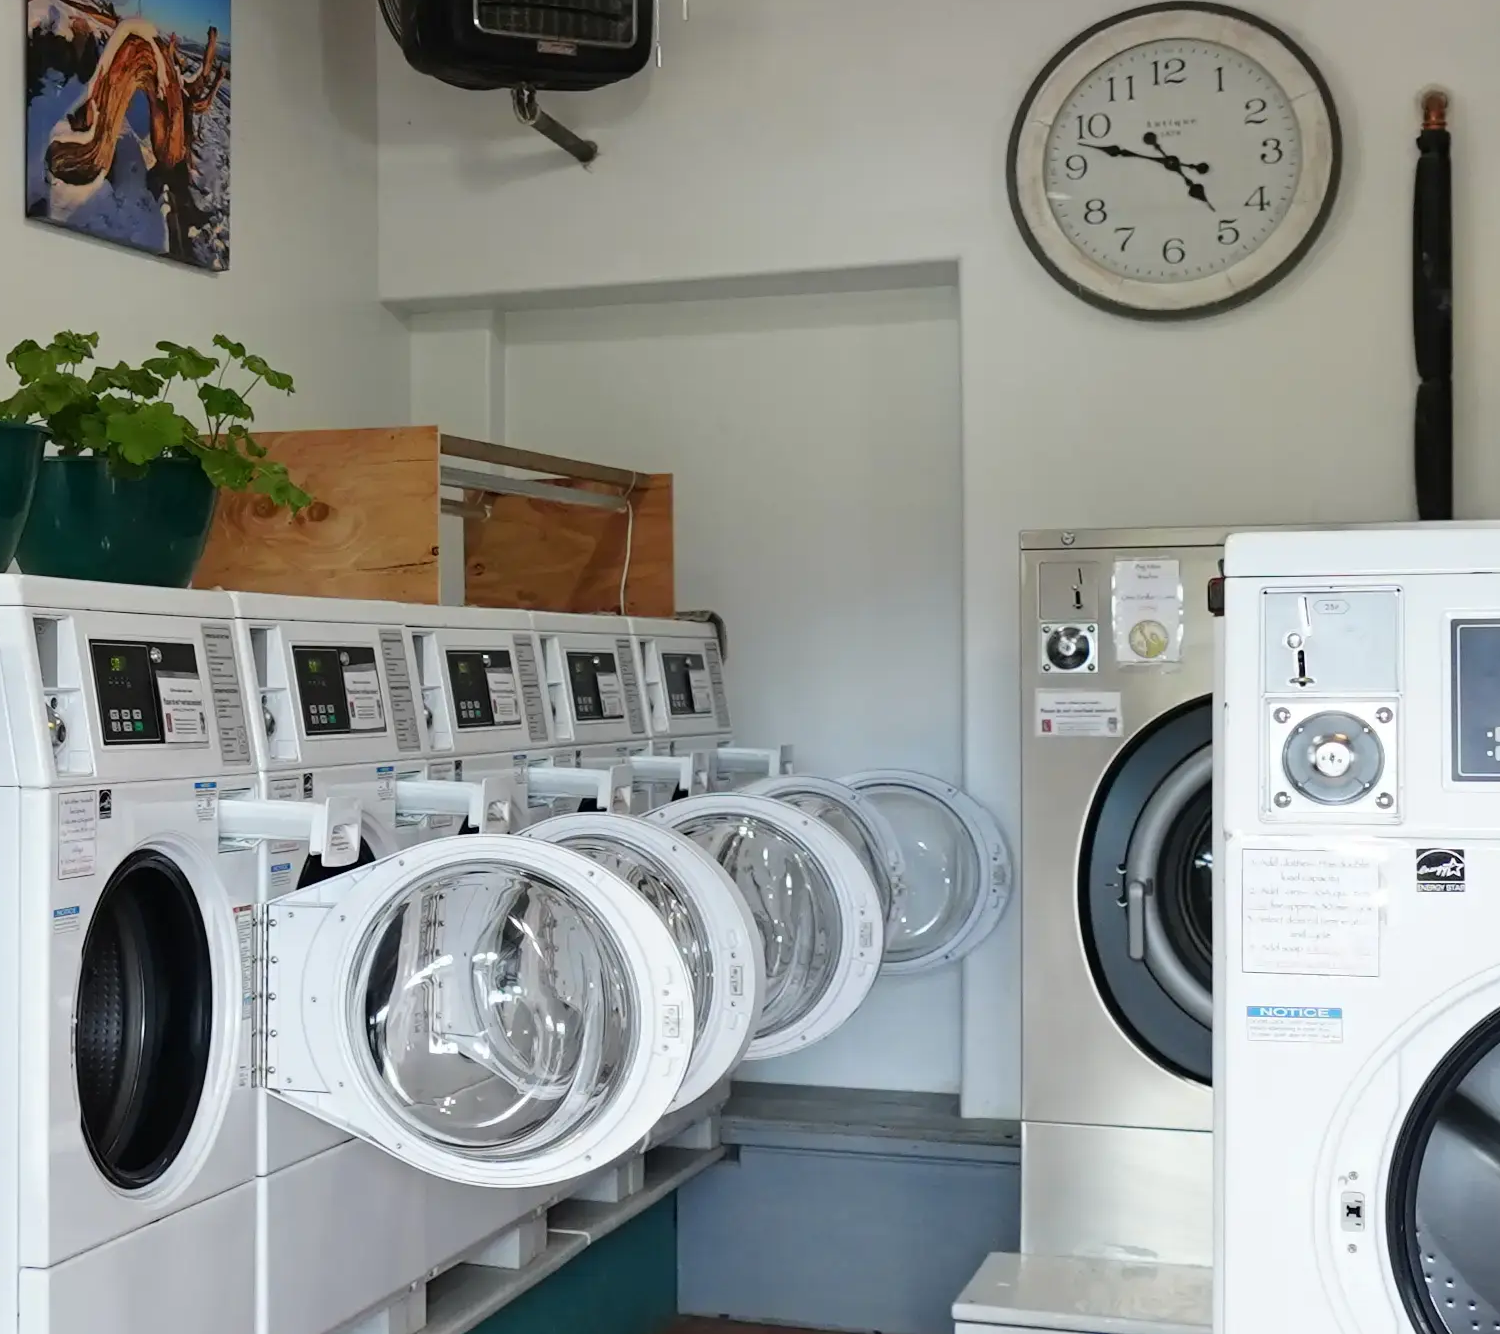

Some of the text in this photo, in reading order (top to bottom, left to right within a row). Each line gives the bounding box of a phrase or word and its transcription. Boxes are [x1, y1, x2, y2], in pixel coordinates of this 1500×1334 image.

[1152, 58, 1187, 86] 12
[1216, 67, 1224, 92] 1
[1106, 75, 1135, 102] 11
[1244, 98, 1268, 124] 2
[1077, 113, 1111, 139] 10
[1260, 138, 1283, 164] 3
[1065, 155, 1088, 180] 9
[1244, 186, 1271, 211] 4
[1084, 199, 1108, 225] 8
[1114, 227, 1135, 252] 7
[1217, 219, 1240, 245] 5
[1162, 238, 1186, 264] 6
[1260, 1008, 1330, 1017] NOTICE
